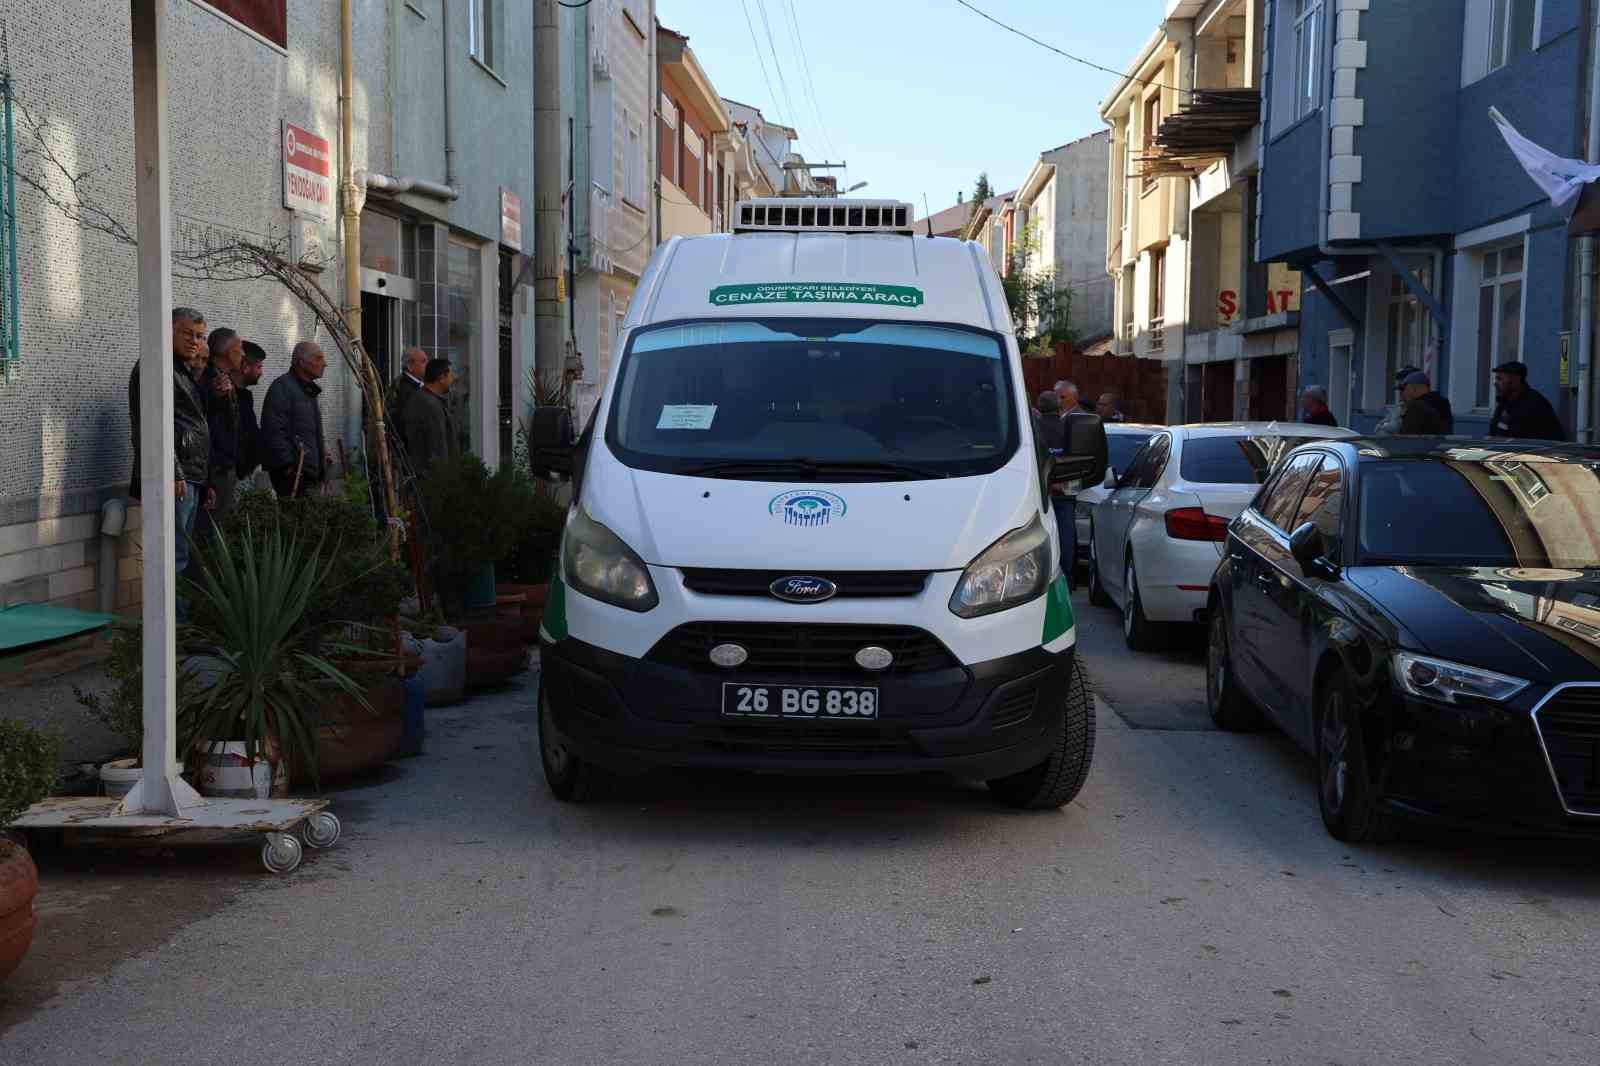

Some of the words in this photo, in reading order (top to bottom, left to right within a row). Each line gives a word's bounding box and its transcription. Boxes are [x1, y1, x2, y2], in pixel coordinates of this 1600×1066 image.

[715, 291, 787, 303] CENAZE
[791, 291, 857, 301] TAŞIMA
[861, 291, 917, 304] ARACI
[785, 580, 821, 594] Ford
[737, 687, 769, 712] 26
[781, 688, 820, 713] BG
[826, 690, 875, 715] 838
